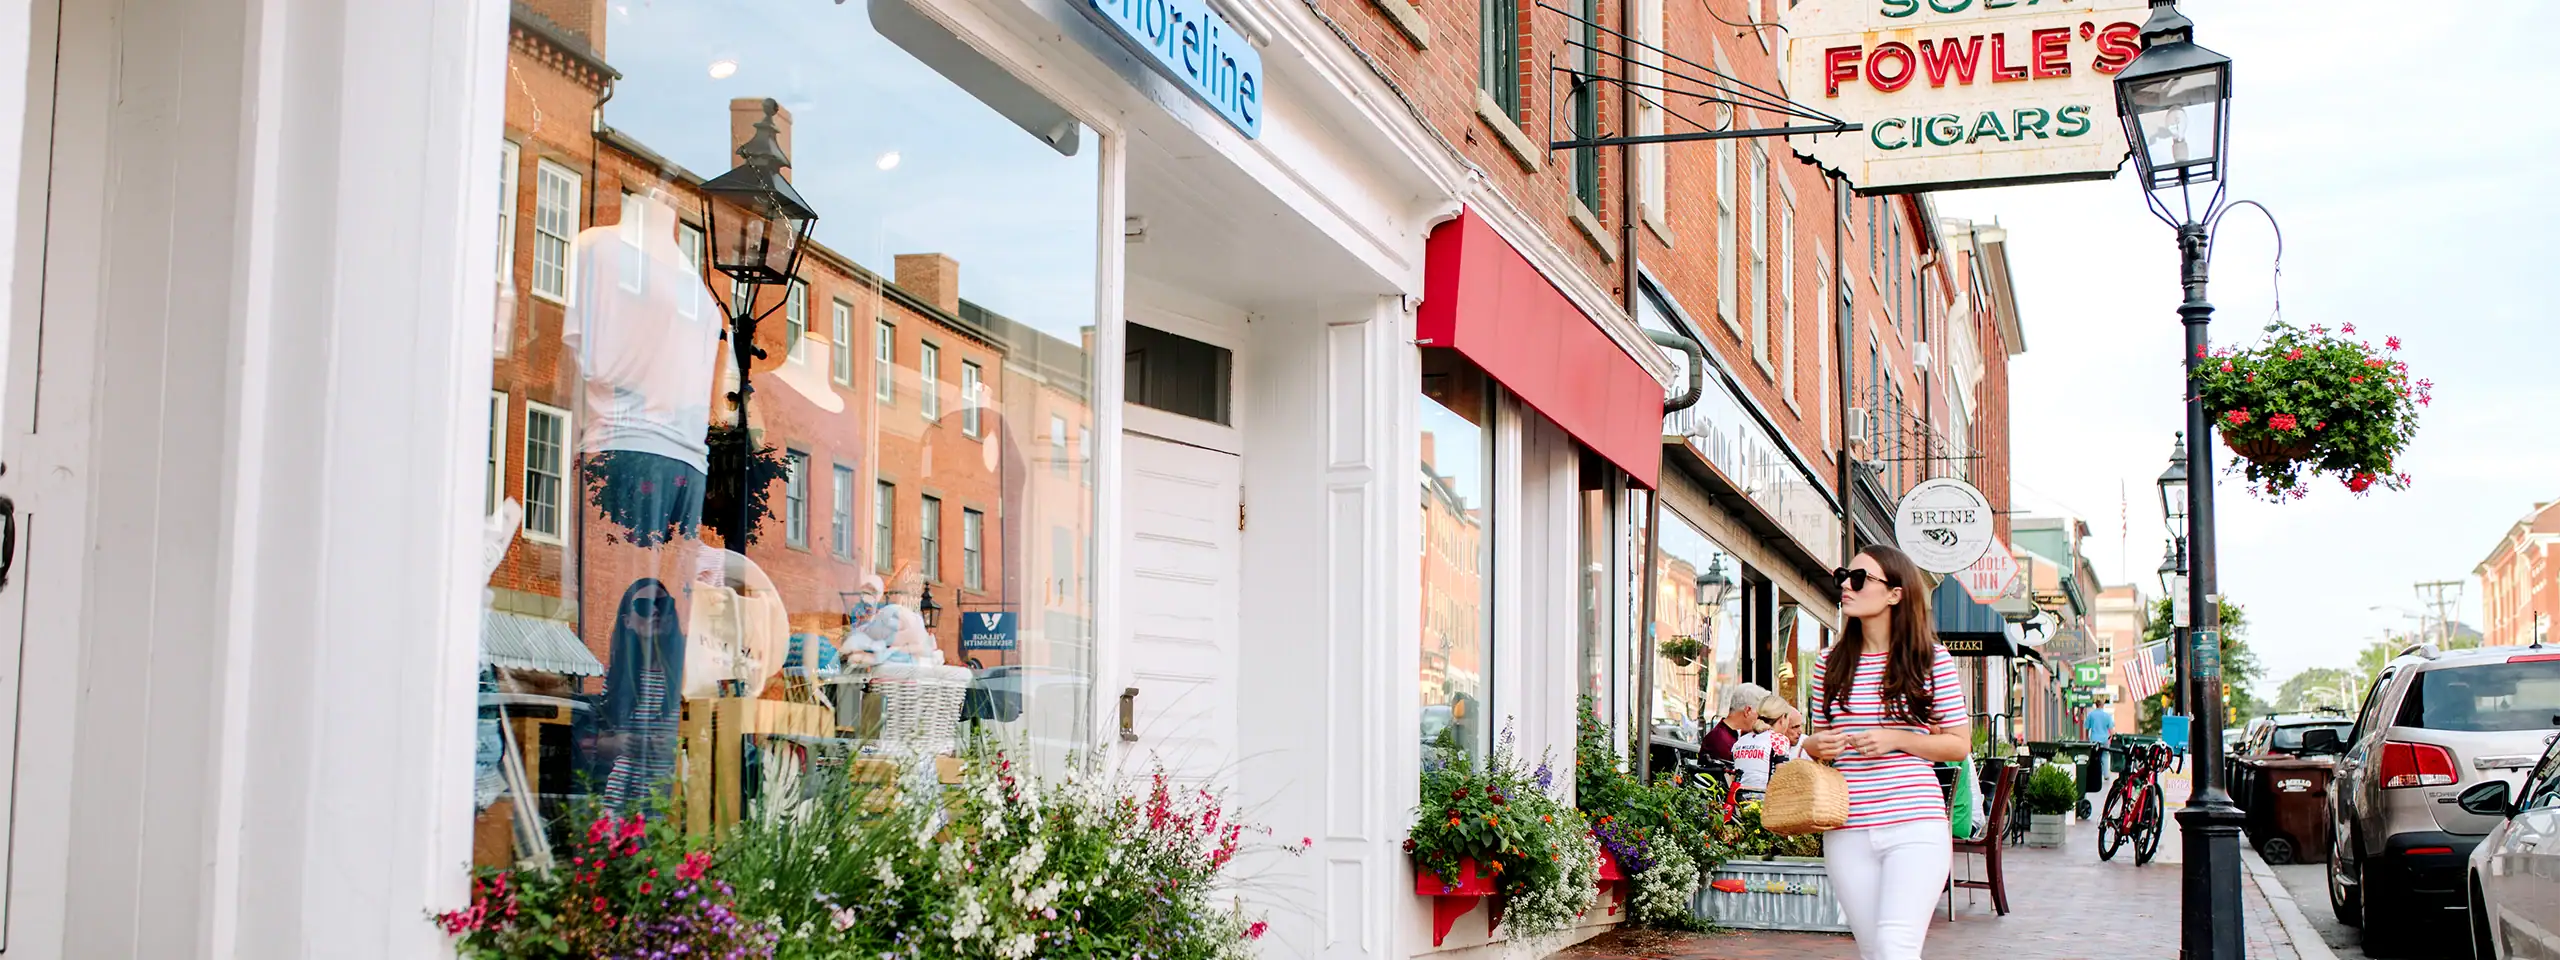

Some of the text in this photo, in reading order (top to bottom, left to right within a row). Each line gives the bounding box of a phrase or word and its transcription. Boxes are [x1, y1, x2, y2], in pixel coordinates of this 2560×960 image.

[1106, 0, 1257, 127] oreline
[1825, 21, 2142, 98] FOWLE'S
[1871, 104, 2091, 150] CIGARS
[1911, 509, 1978, 526] BRINE
[1973, 572, 1999, 591] INN
[2077, 667, 2098, 680] TD
